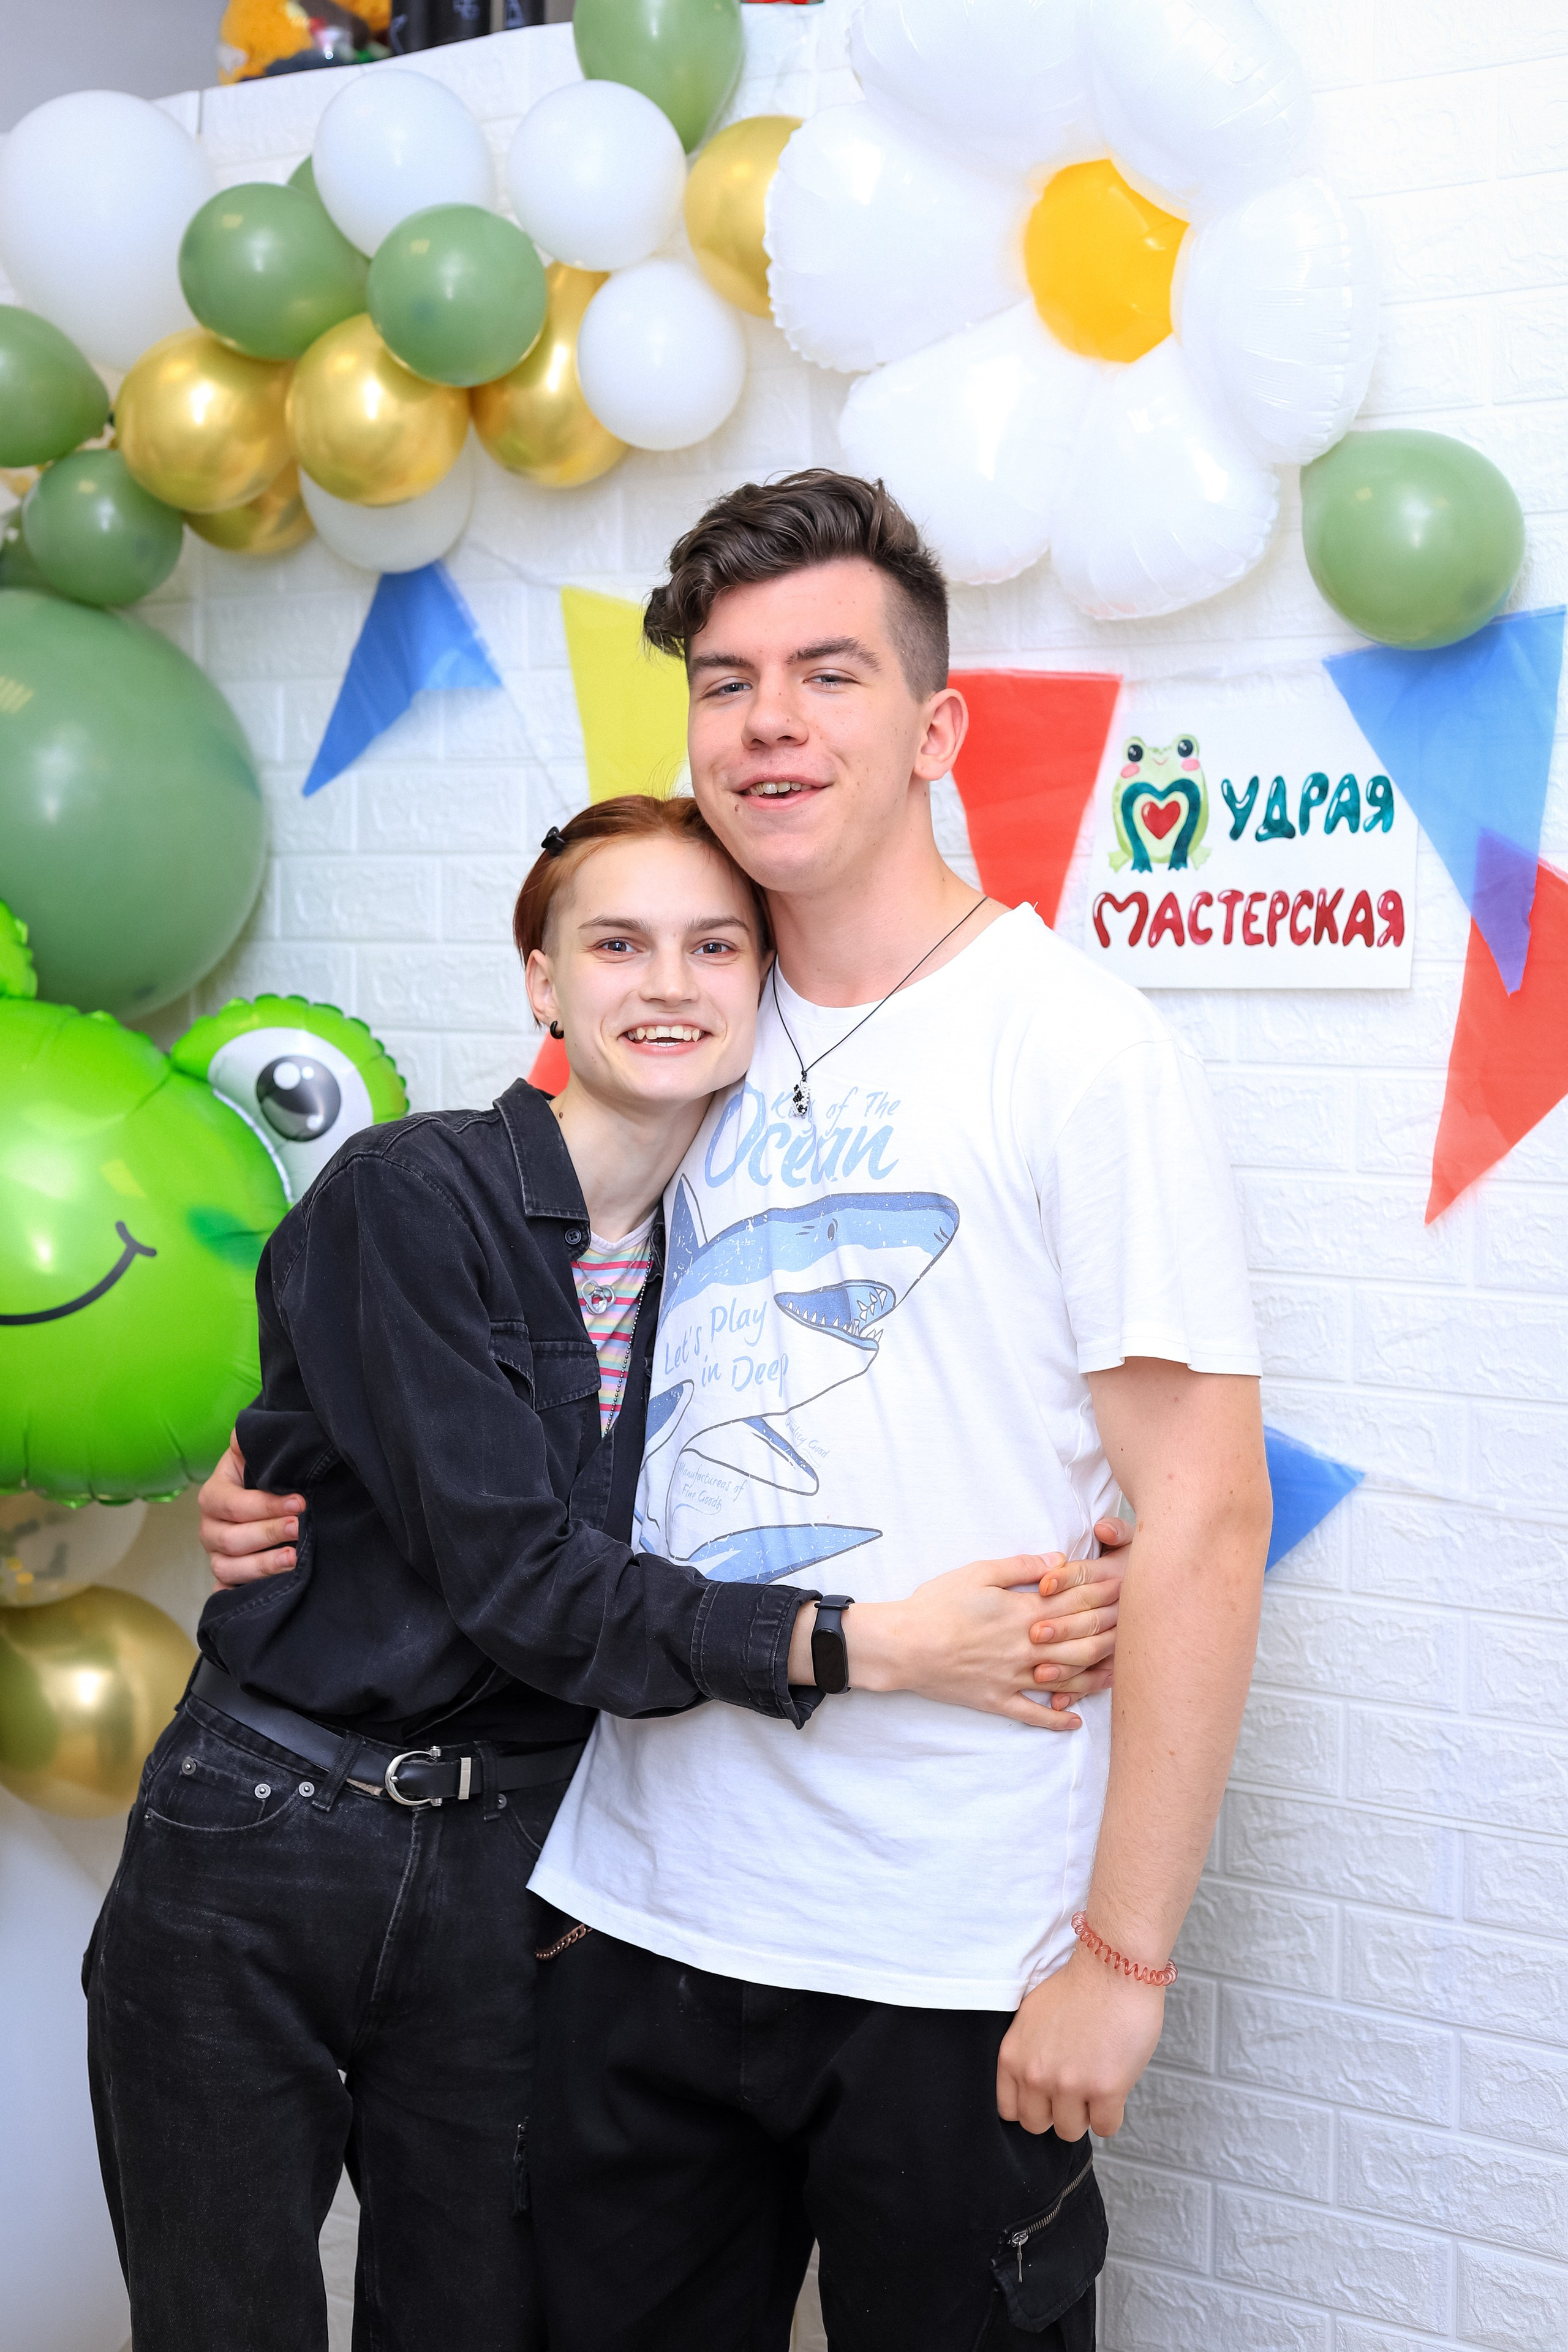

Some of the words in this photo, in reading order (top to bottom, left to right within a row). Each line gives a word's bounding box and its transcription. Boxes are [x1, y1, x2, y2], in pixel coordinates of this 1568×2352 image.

[1093, 888, 1405, 948] МАСТЕРСКАЯ
[704, 1081, 899, 1188] Ocean
[825, 1087, 859, 1137] of
[864, 1091, 902, 1119] The
[665, 1325, 703, 1375] Let's
[701, 1354, 722, 1388] in
[731, 1352, 789, 1398] Deep
[733, 1479, 747, 1502] of
